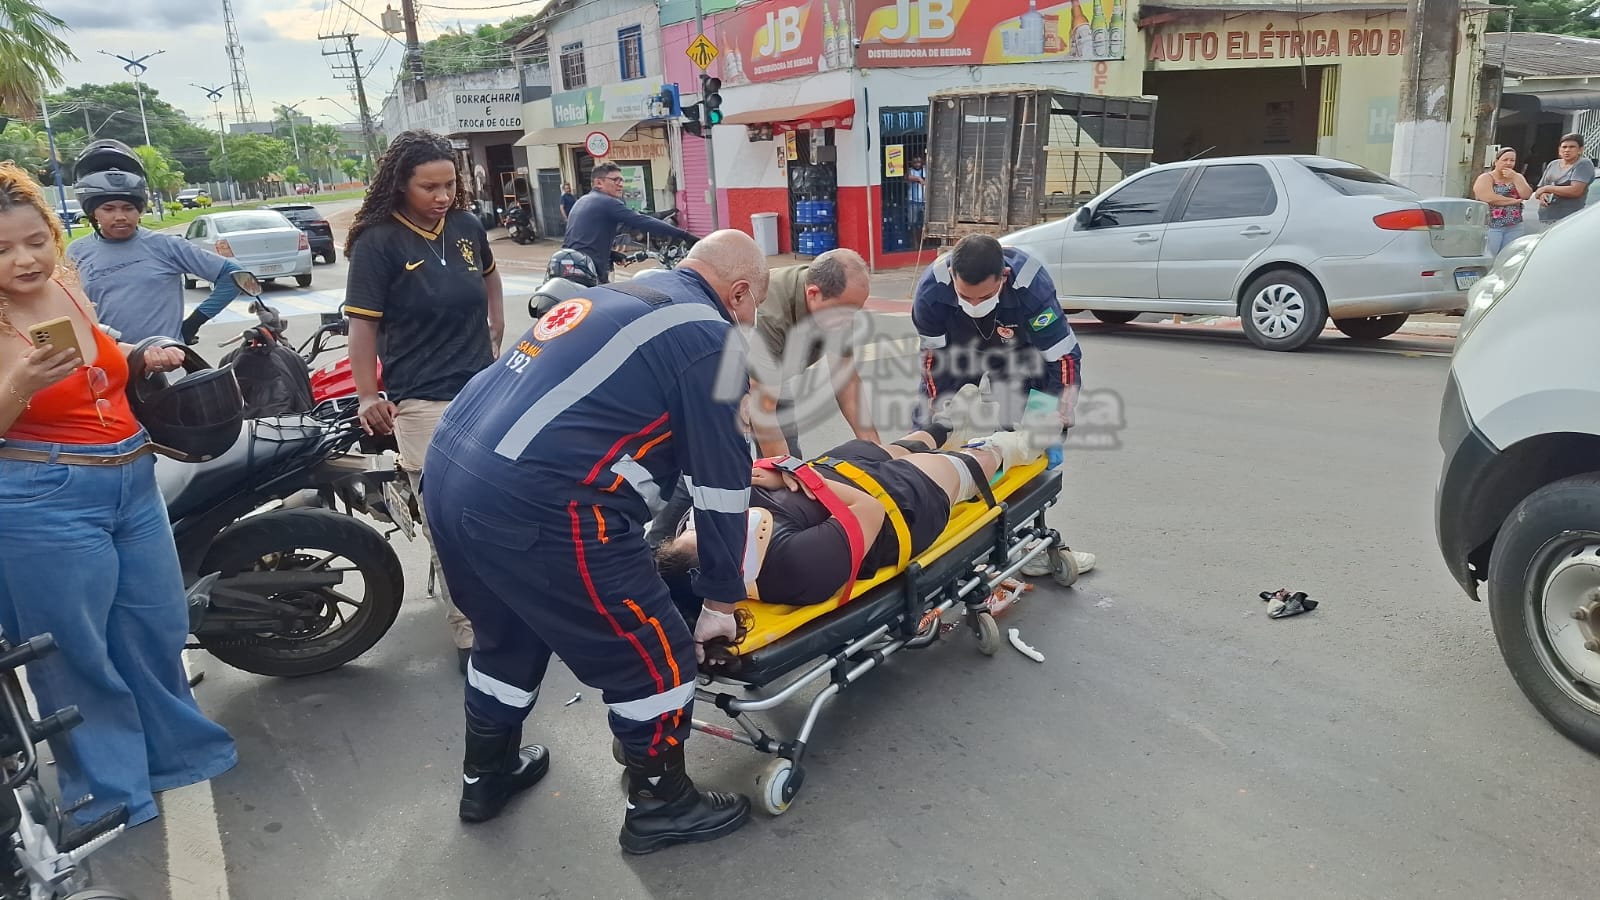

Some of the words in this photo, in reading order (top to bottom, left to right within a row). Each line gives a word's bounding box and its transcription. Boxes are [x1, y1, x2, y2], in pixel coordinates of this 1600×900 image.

[880, 0, 956, 41] JB
[760, 6, 802, 57] JB
[1149, 31, 1219, 61] AUTO
[1226, 22, 1340, 60] ELÉTRICA
[1347, 28, 1384, 57] RIO
[868, 49, 927, 59] DISTRIBUIDORA
[928, 48, 939, 57] DE
[940, 47, 972, 57] BEBIDAS
[754, 60, 787, 75] DISTRIBUIDORA
[786, 59, 794, 69] DE
[793, 56, 814, 68] BEBIDAS
[455, 92, 521, 104] BORRACHARIA
[485, 106, 492, 116] E
[555, 103, 587, 123] Heliar
[458, 119, 485, 128] TROCA
[486, 118, 497, 127] DE
[517, 340, 543, 358] SAMU
[505, 350, 532, 373] 192
